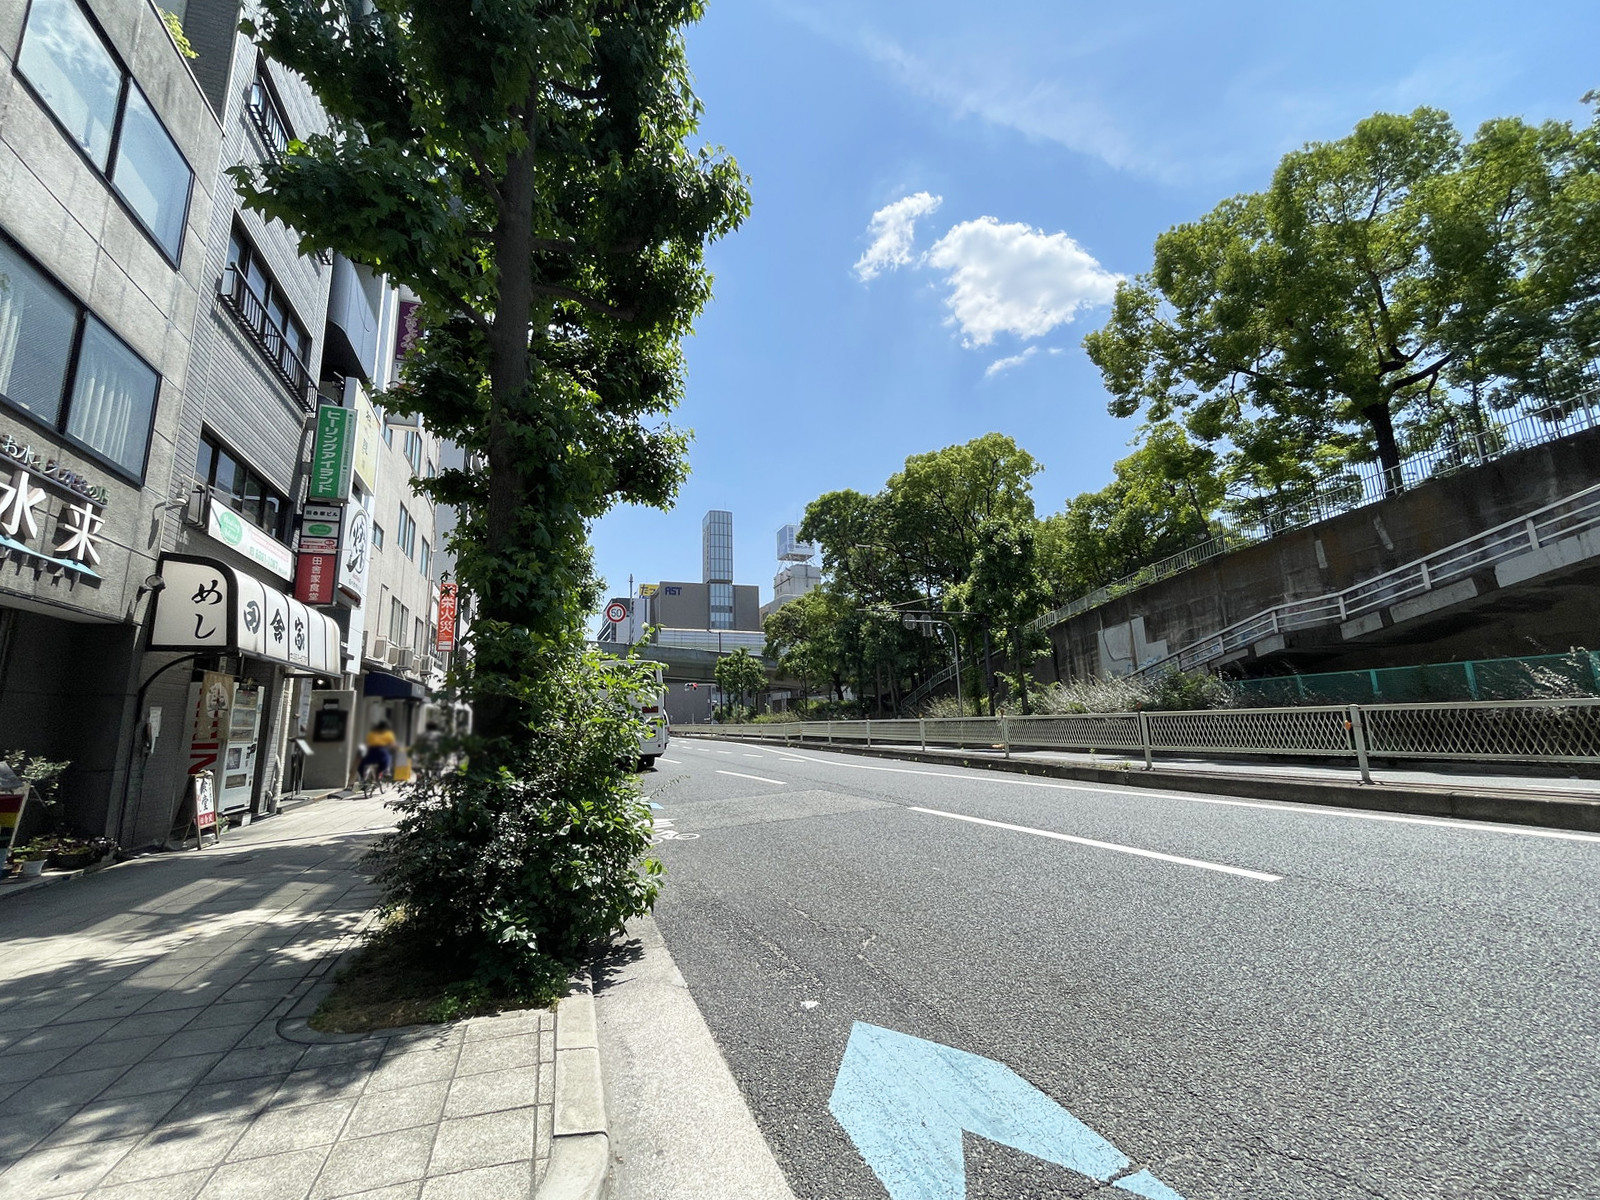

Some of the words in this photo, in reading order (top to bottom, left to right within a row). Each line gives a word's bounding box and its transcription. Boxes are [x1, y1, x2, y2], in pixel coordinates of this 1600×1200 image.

[319, 410, 340, 493] ヒーリングアイランド
[665, 586, 682, 595] AST
[191, 579, 223, 639] めし
[611, 609, 622, 617] 50
